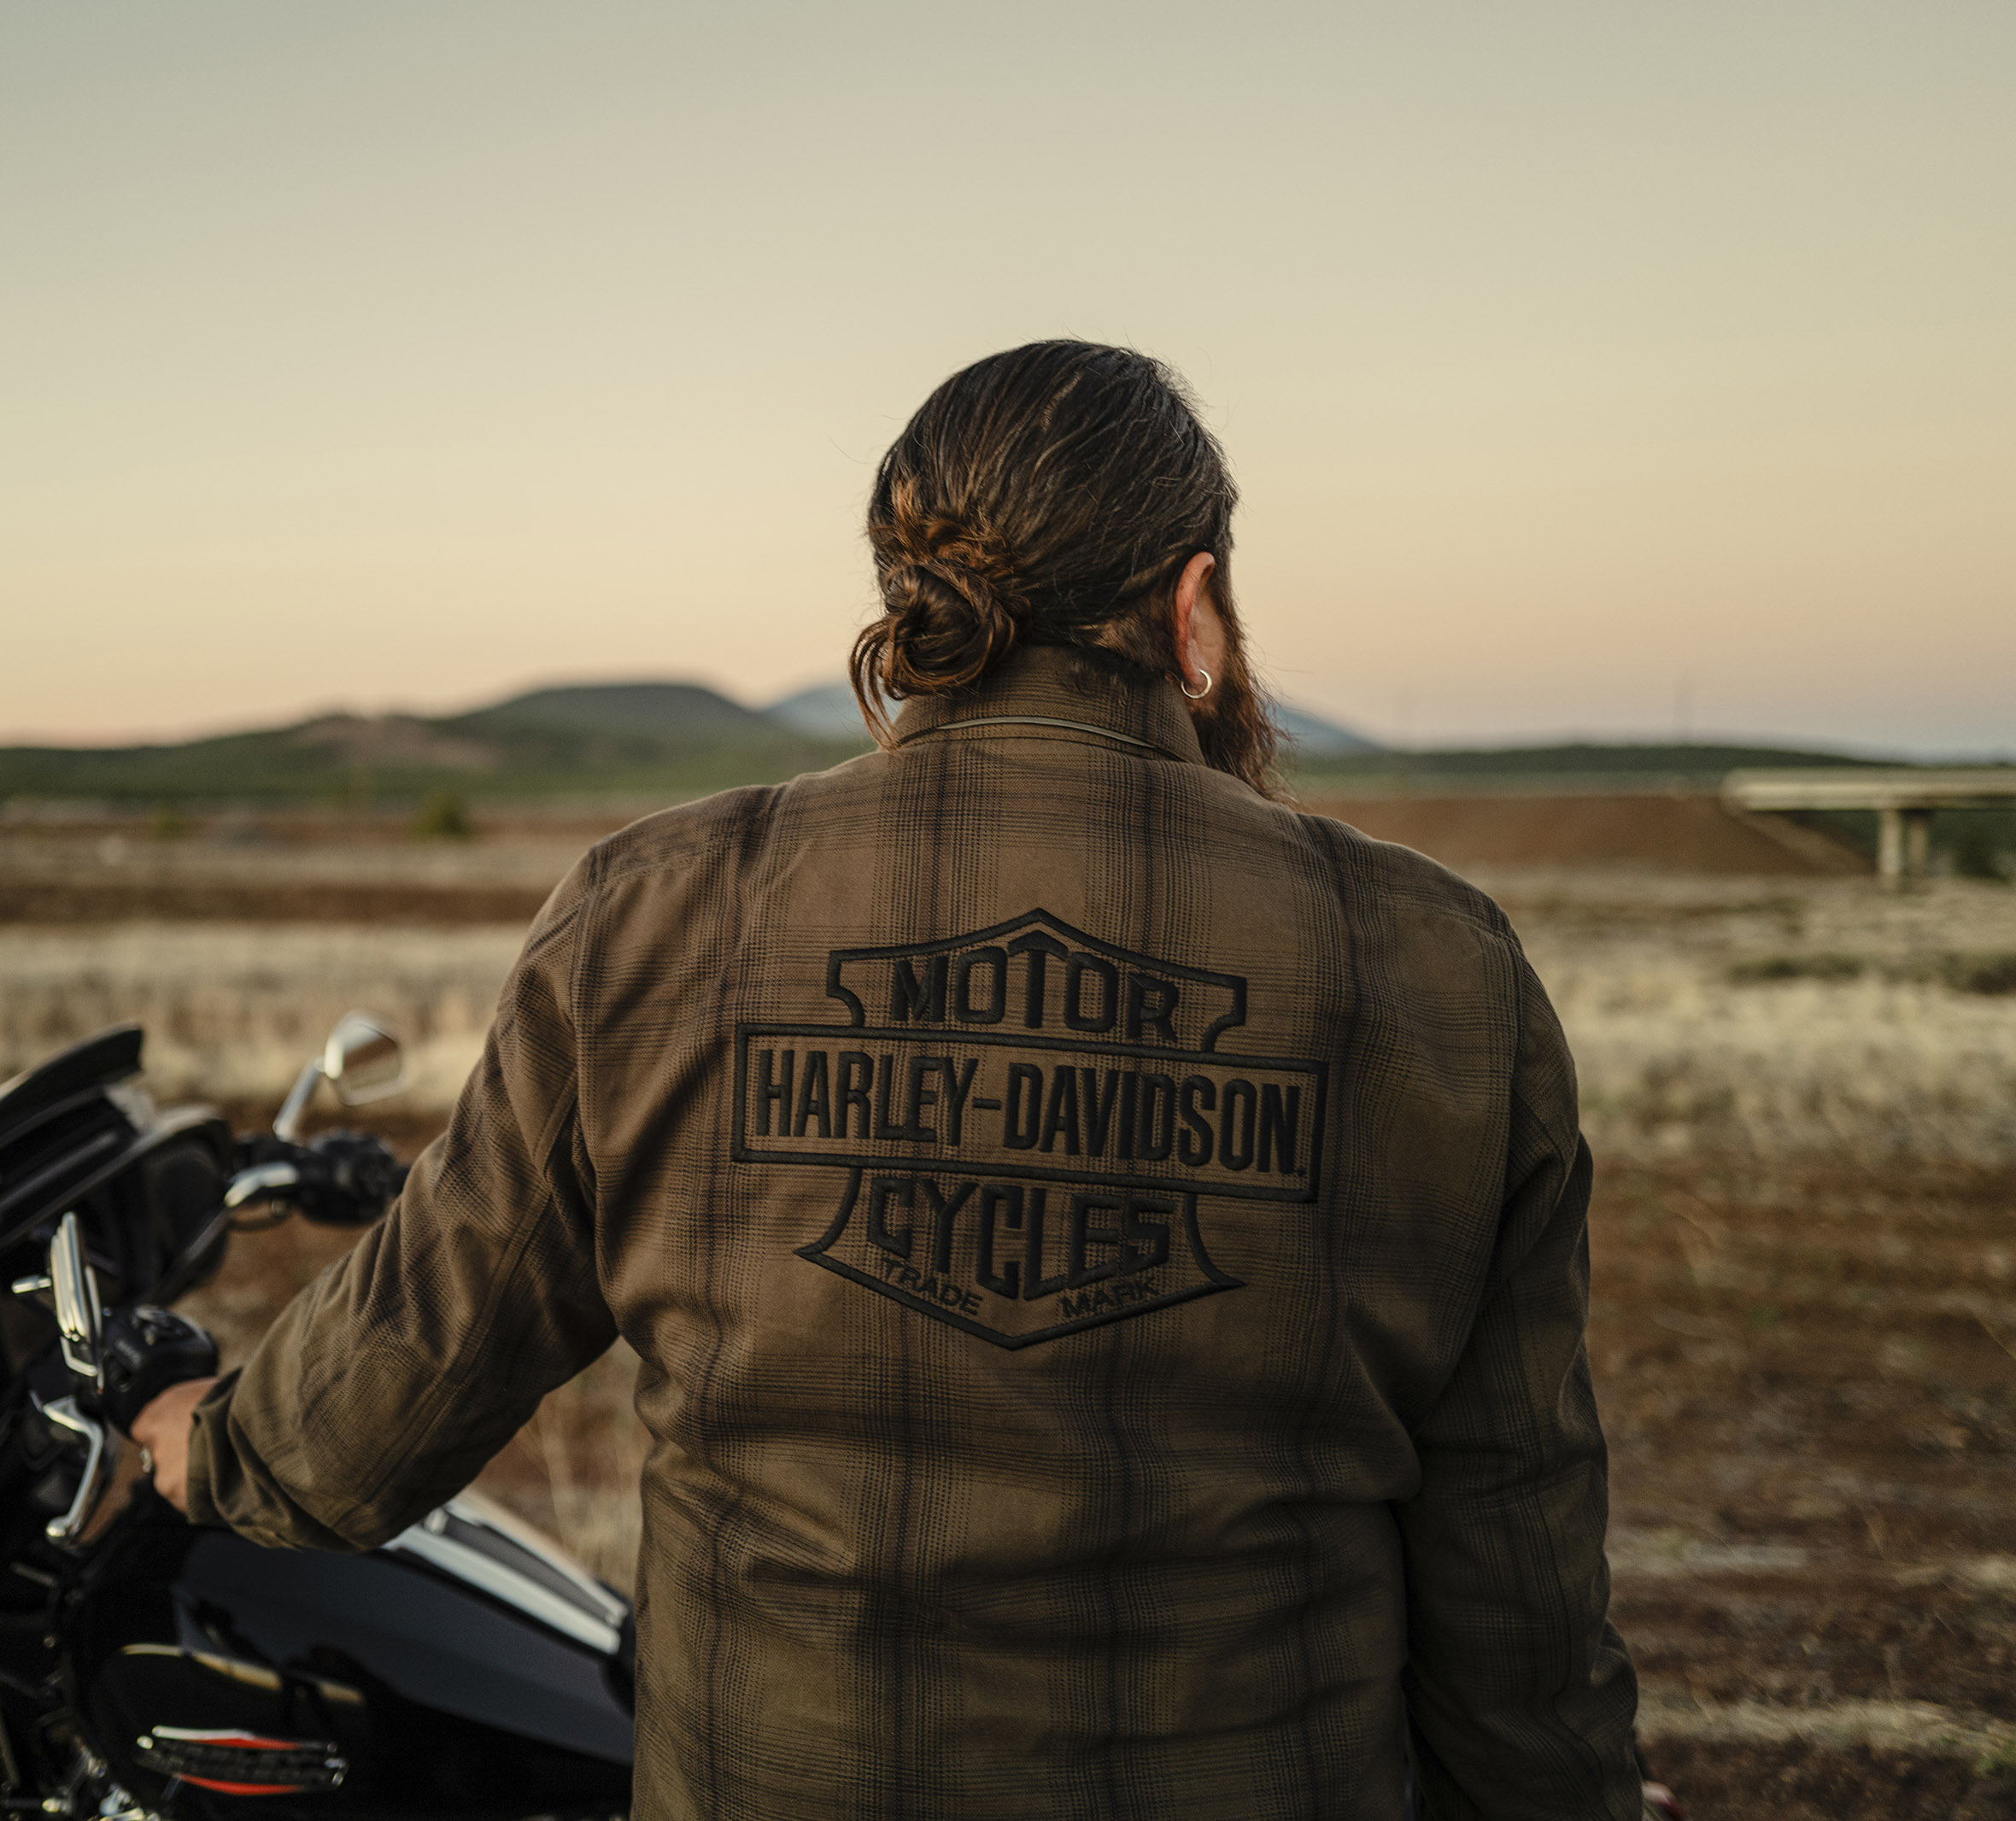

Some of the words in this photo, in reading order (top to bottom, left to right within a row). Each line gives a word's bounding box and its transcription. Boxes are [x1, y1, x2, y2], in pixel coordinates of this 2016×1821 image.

[891, 929, 1180, 1041] MOTOR
[867, 1177, 1175, 1301] CYCLES
[882, 1257, 983, 1316] TRADE
[1060, 1279, 1161, 1318] MARK
